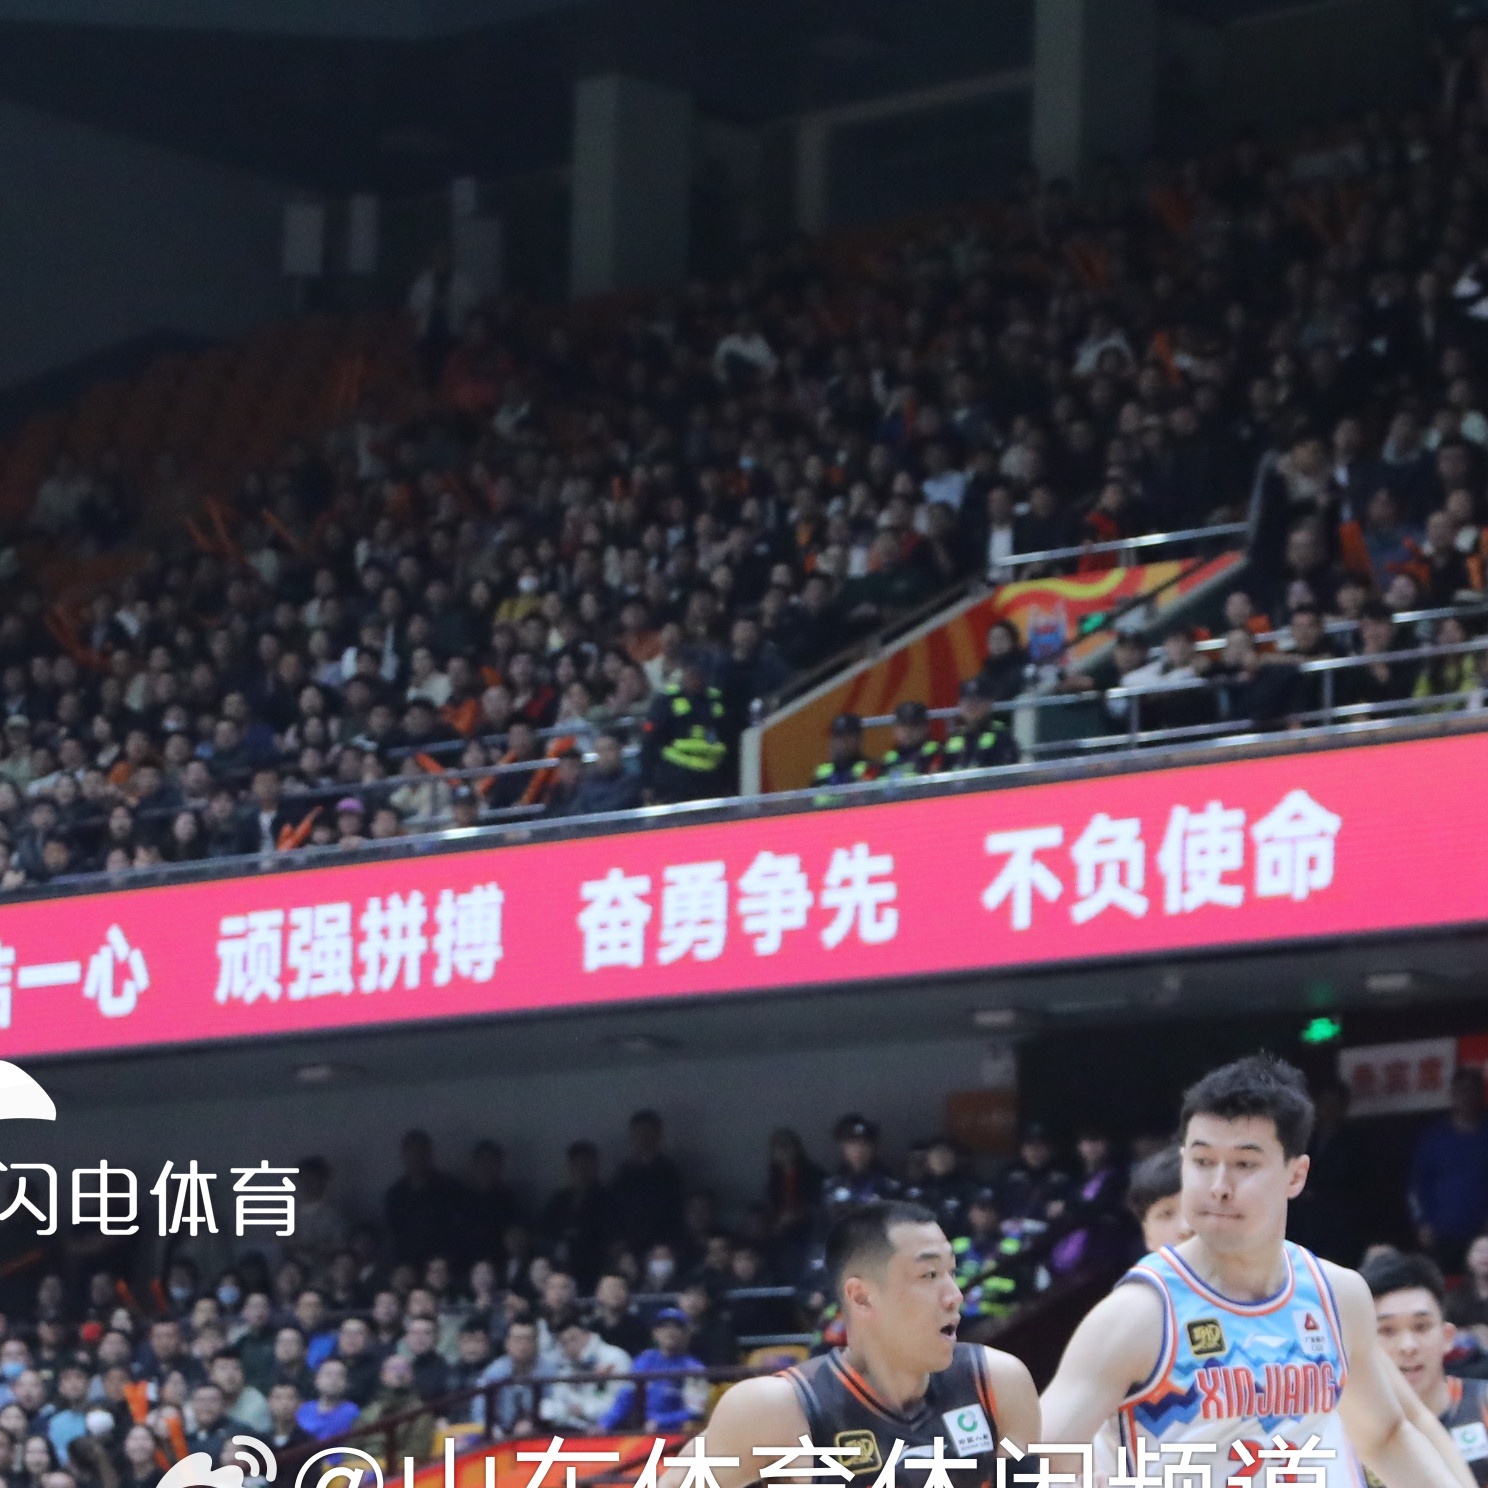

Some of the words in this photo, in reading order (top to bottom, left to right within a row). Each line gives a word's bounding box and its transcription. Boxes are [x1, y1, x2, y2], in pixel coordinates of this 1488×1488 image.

[214, 880, 504, 1005] 顽强拼搏
[577, 841, 900, 973] 奋勇争先
[981, 788, 1343, 932] 不负使命
[1196, 1361, 1336, 1420] XINJIANG
